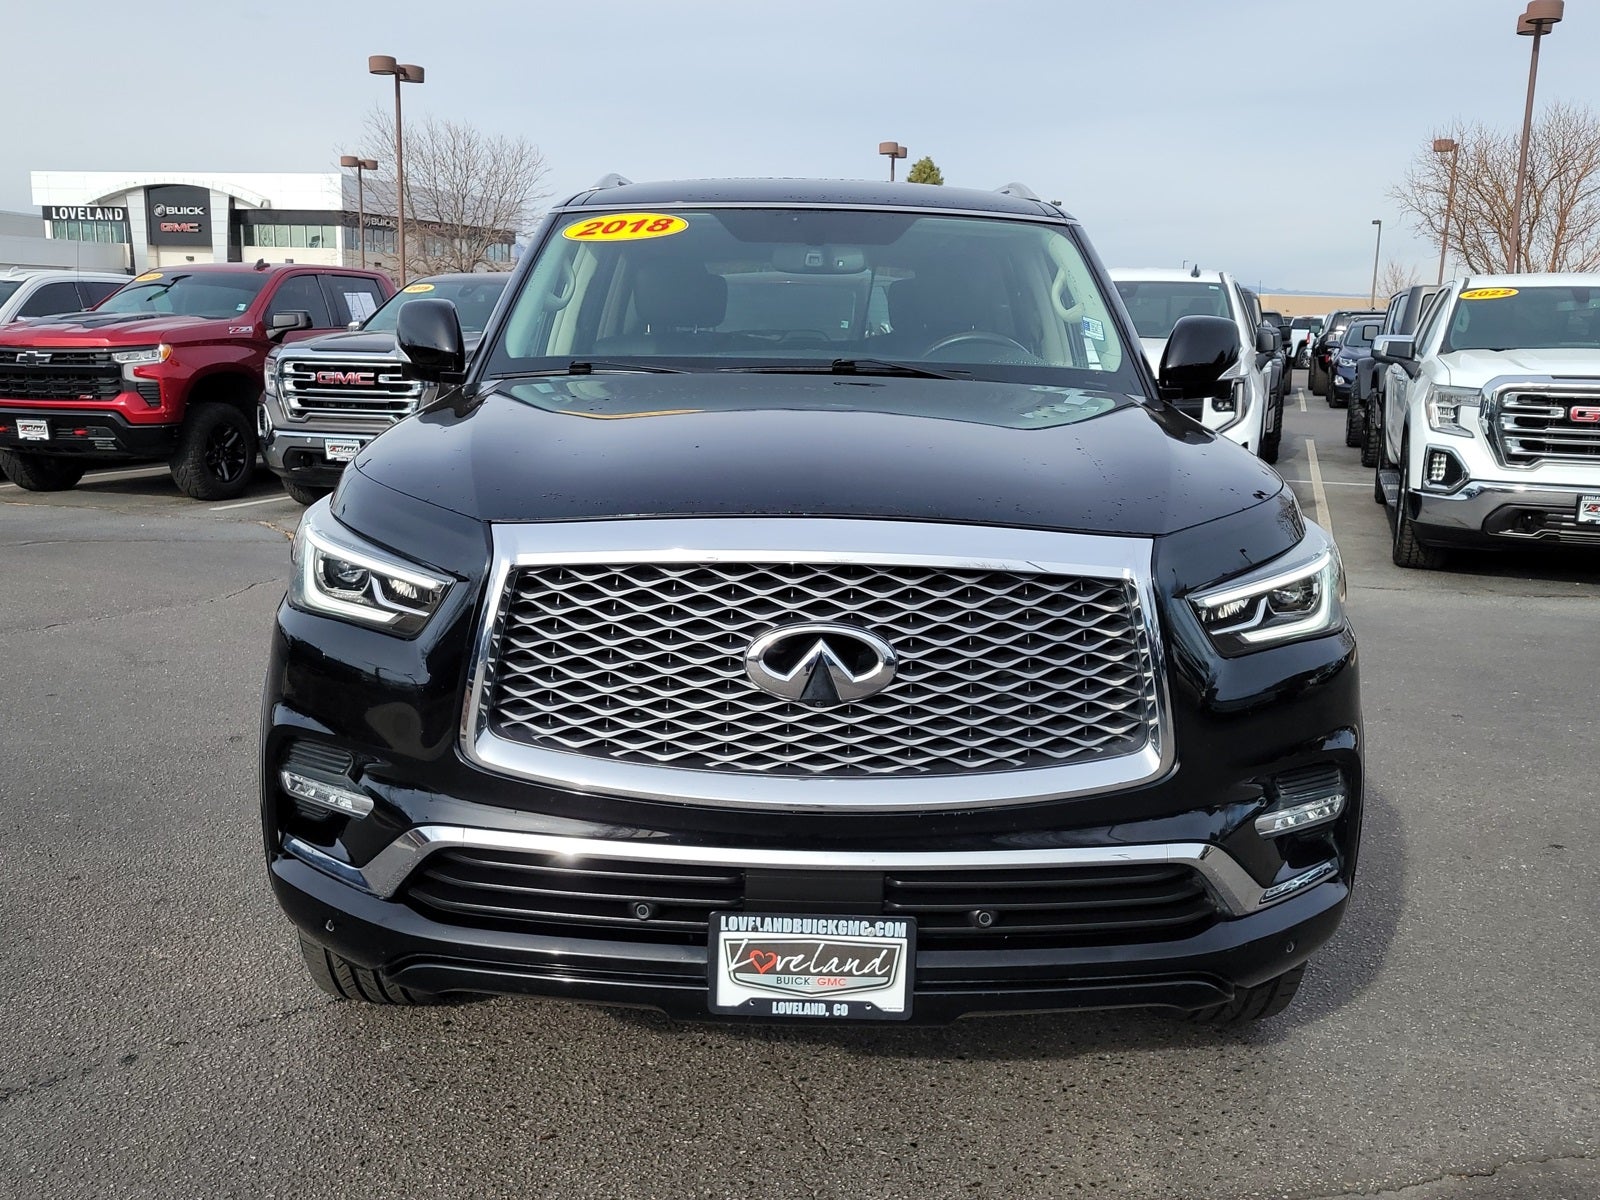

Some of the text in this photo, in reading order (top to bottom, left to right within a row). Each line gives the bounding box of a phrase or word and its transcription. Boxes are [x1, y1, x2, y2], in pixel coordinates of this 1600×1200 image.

[52, 206, 124, 221] LOVELAND
[166, 206, 204, 215] BUICK
[160, 223, 199, 232] GMC
[575, 218, 674, 237] 2018
[1466, 289, 1513, 298] 2022
[317, 371, 375, 385] GMC
[720, 915, 907, 937] LOVELANDBUICKGMCCOM
[776, 976, 847, 986] BUICK GMC
[771, 1002, 849, 1017] LOVELAND, CO
